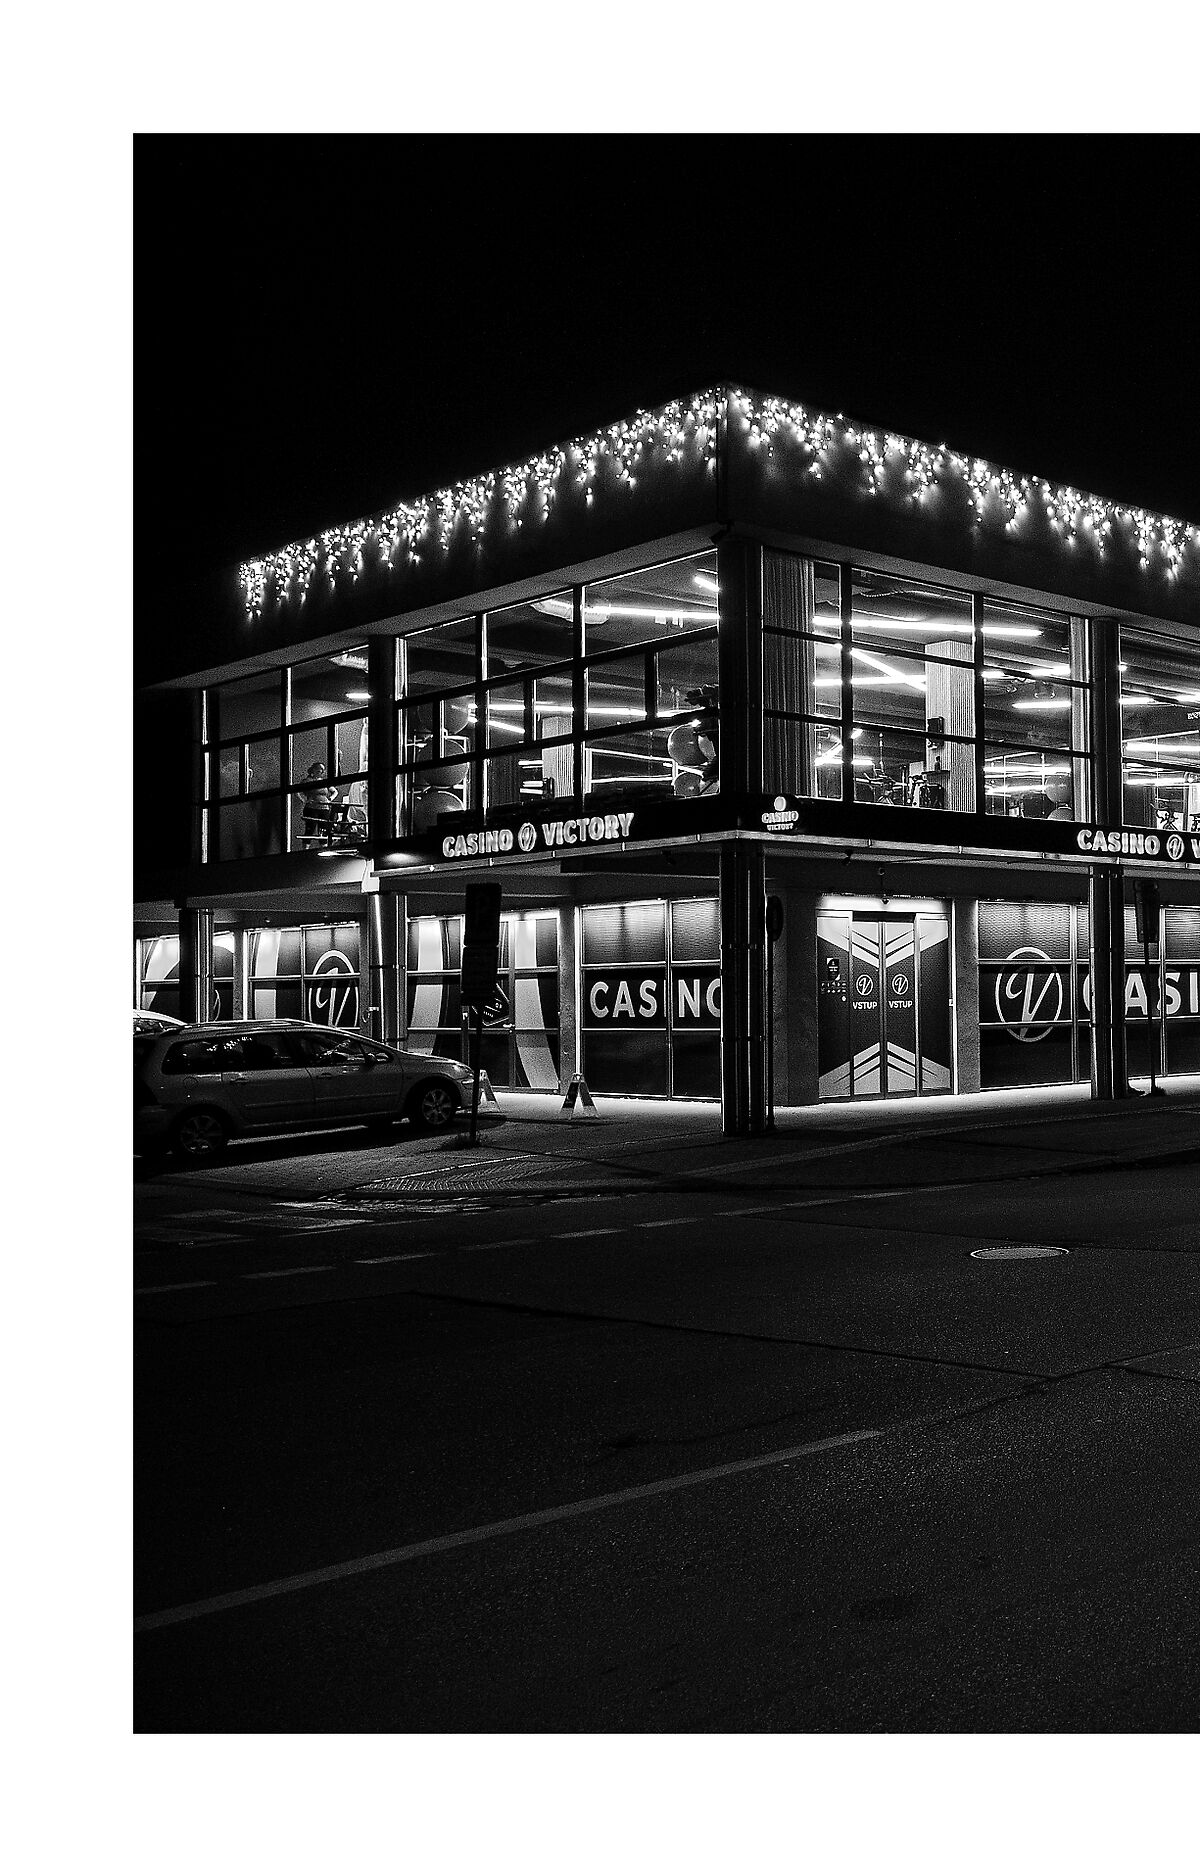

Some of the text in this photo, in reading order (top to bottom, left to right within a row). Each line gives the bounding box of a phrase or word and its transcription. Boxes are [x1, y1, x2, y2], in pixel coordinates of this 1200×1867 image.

[761, 811, 799, 823] CASINO
[442, 829, 514, 858] CASINO
[541, 812, 635, 846] VICTORY
[1077, 829, 1160, 856] CASINO
[852, 1001, 878, 1010] VSTUP
[888, 1000, 912, 1009] VSTUP
